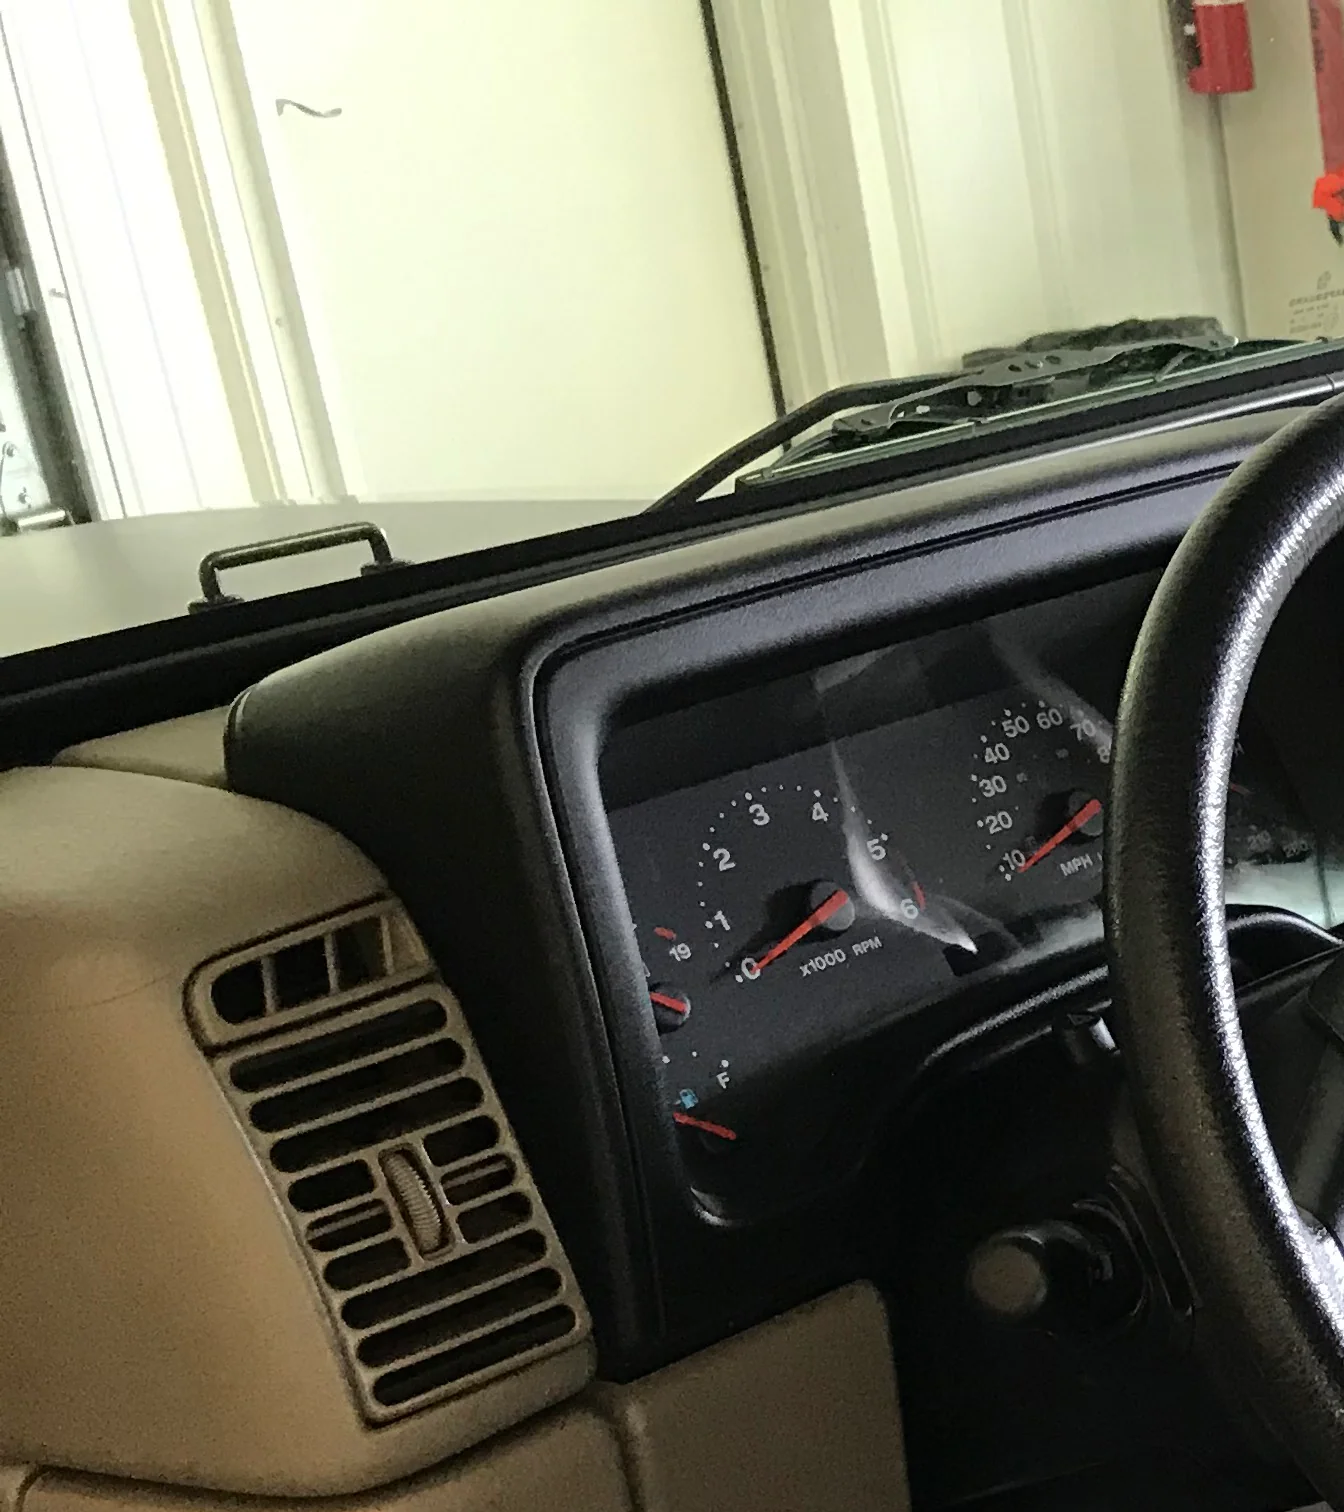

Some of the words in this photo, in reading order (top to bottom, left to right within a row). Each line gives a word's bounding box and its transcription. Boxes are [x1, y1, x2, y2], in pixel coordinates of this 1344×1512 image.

[1001, 715, 1031, 738] 50
[1036, 708, 1063, 730] 60
[1070, 719, 1097, 741] 70
[984, 742, 1011, 764] 40
[1097, 746, 1111, 764] 8
[979, 775, 1007, 798] 30
[749, 803, 770, 826] 3
[811, 802, 829, 822] 4
[985, 811, 1013, 834] 20
[713, 848, 736, 872] 2
[866, 838, 887, 860] 5
[1002, 849, 1026, 871] 10
[1059, 853, 1094, 877] MPH
[899, 897, 919, 920] 6
[713, 910, 731, 931] 1
[668, 942, 692, 962] 19
[851, 935, 883, 958] RPM
[740, 957, 761, 981] 0
[715, 1071, 731, 1090] F
